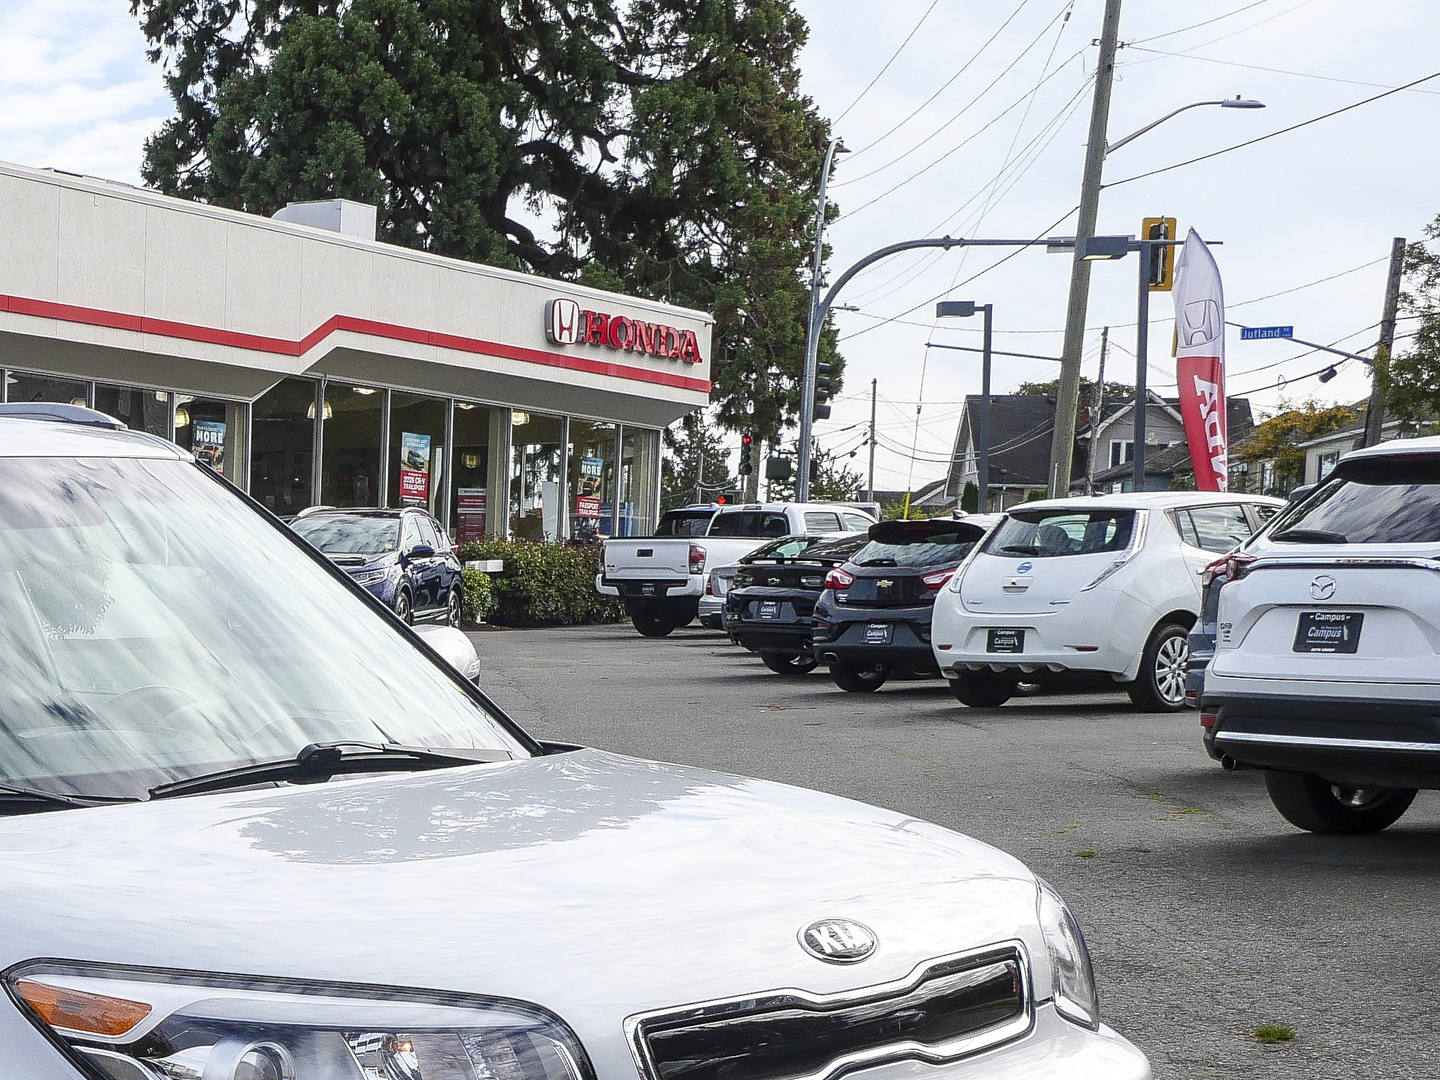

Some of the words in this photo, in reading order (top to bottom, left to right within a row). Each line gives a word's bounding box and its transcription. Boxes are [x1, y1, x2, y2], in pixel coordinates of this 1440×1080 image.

[583, 310, 703, 364] HONDA
[1243, 328, 1280, 339] Jutland
[196, 430, 224, 444] MORE
[581, 464, 602, 476] MORE
[1315, 613, 1346, 623] Campus
[1308, 626, 1342, 640] Campus
[807, 922, 873, 954] KIA
